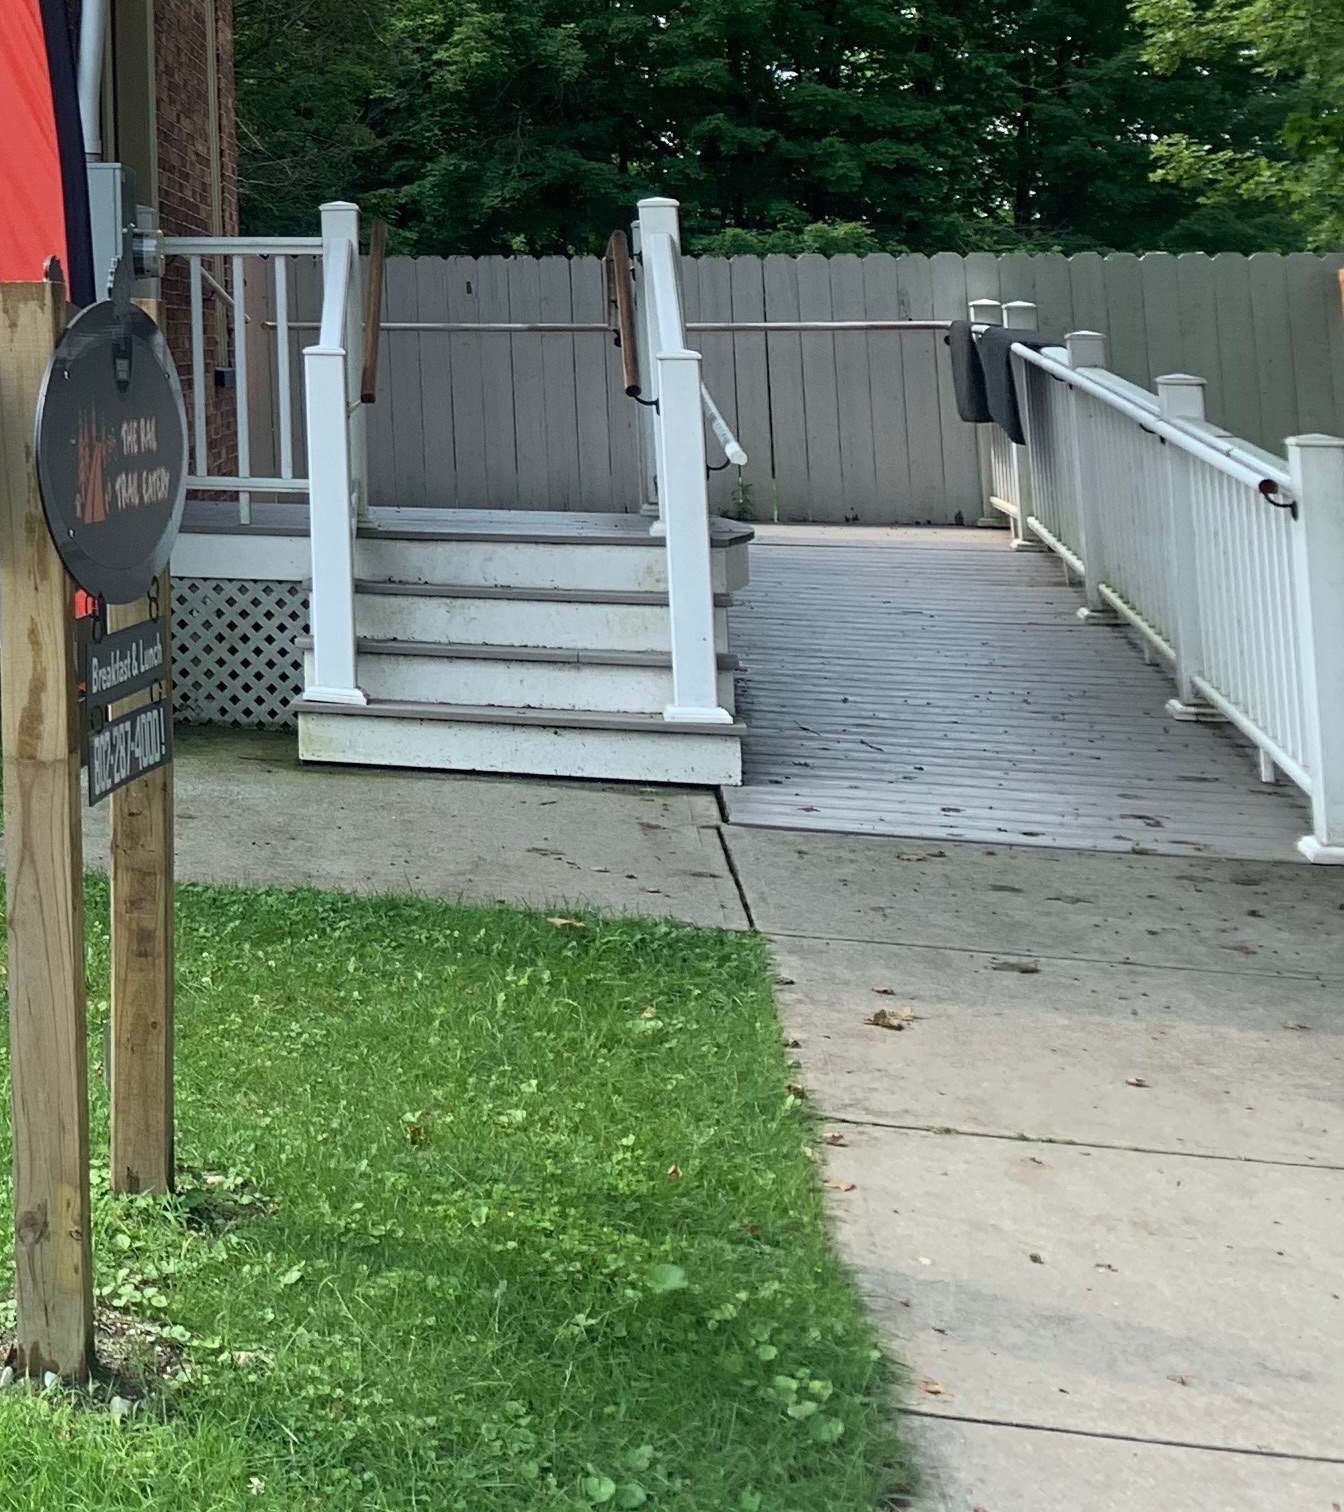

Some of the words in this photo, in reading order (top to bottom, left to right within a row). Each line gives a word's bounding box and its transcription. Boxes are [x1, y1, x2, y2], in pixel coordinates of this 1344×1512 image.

[121, 419, 138, 457] THE
[91, 648, 132, 694] Breakfast
[139, 631, 164, 673] Lunch
